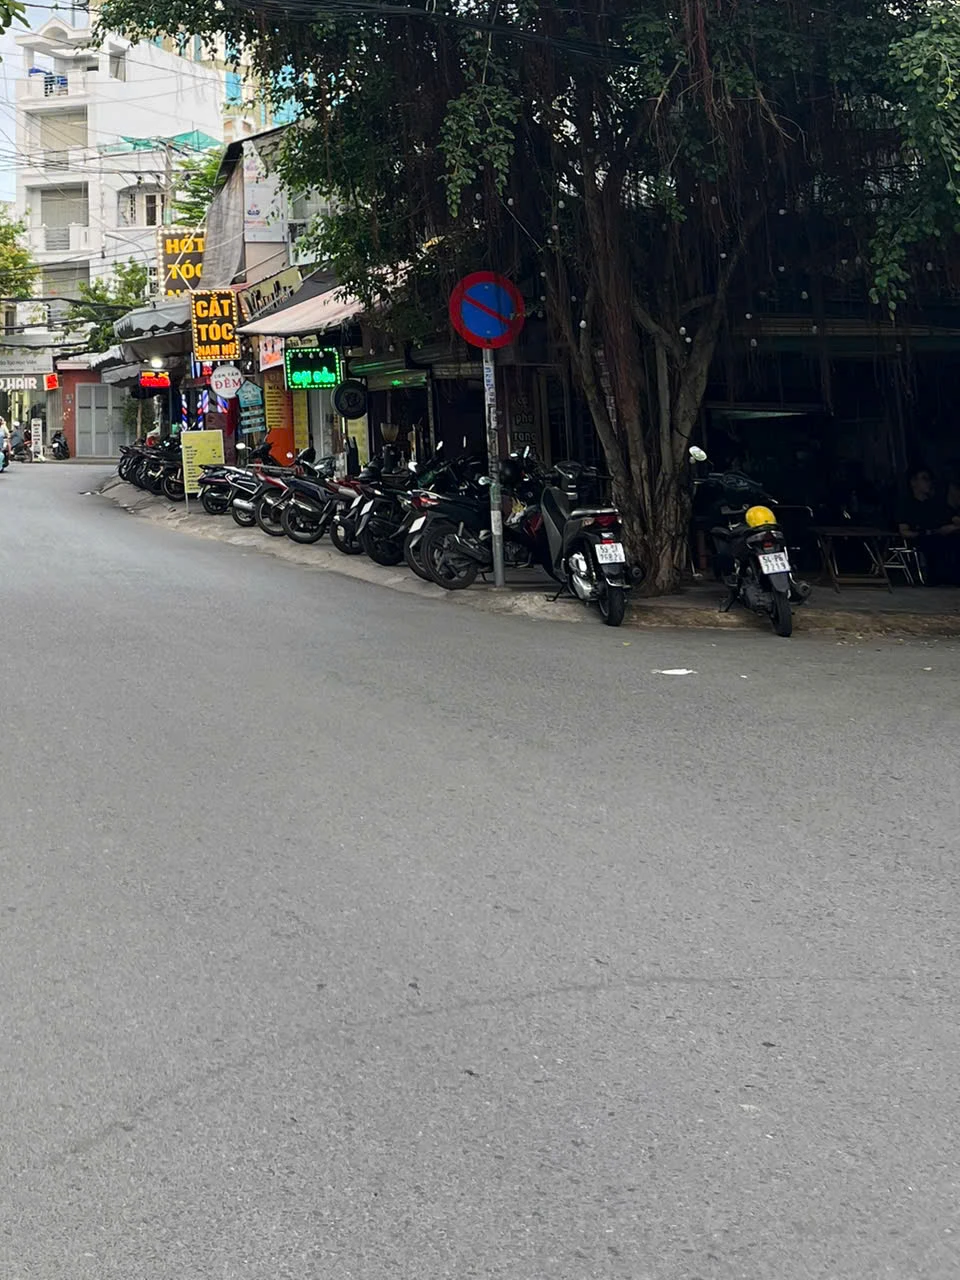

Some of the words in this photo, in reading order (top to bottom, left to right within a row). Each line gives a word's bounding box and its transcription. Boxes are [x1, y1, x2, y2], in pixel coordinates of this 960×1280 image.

[195, 294, 231, 318] CẮT
[197, 320, 234, 341] TÓC
[198, 344, 220, 356] NAM
